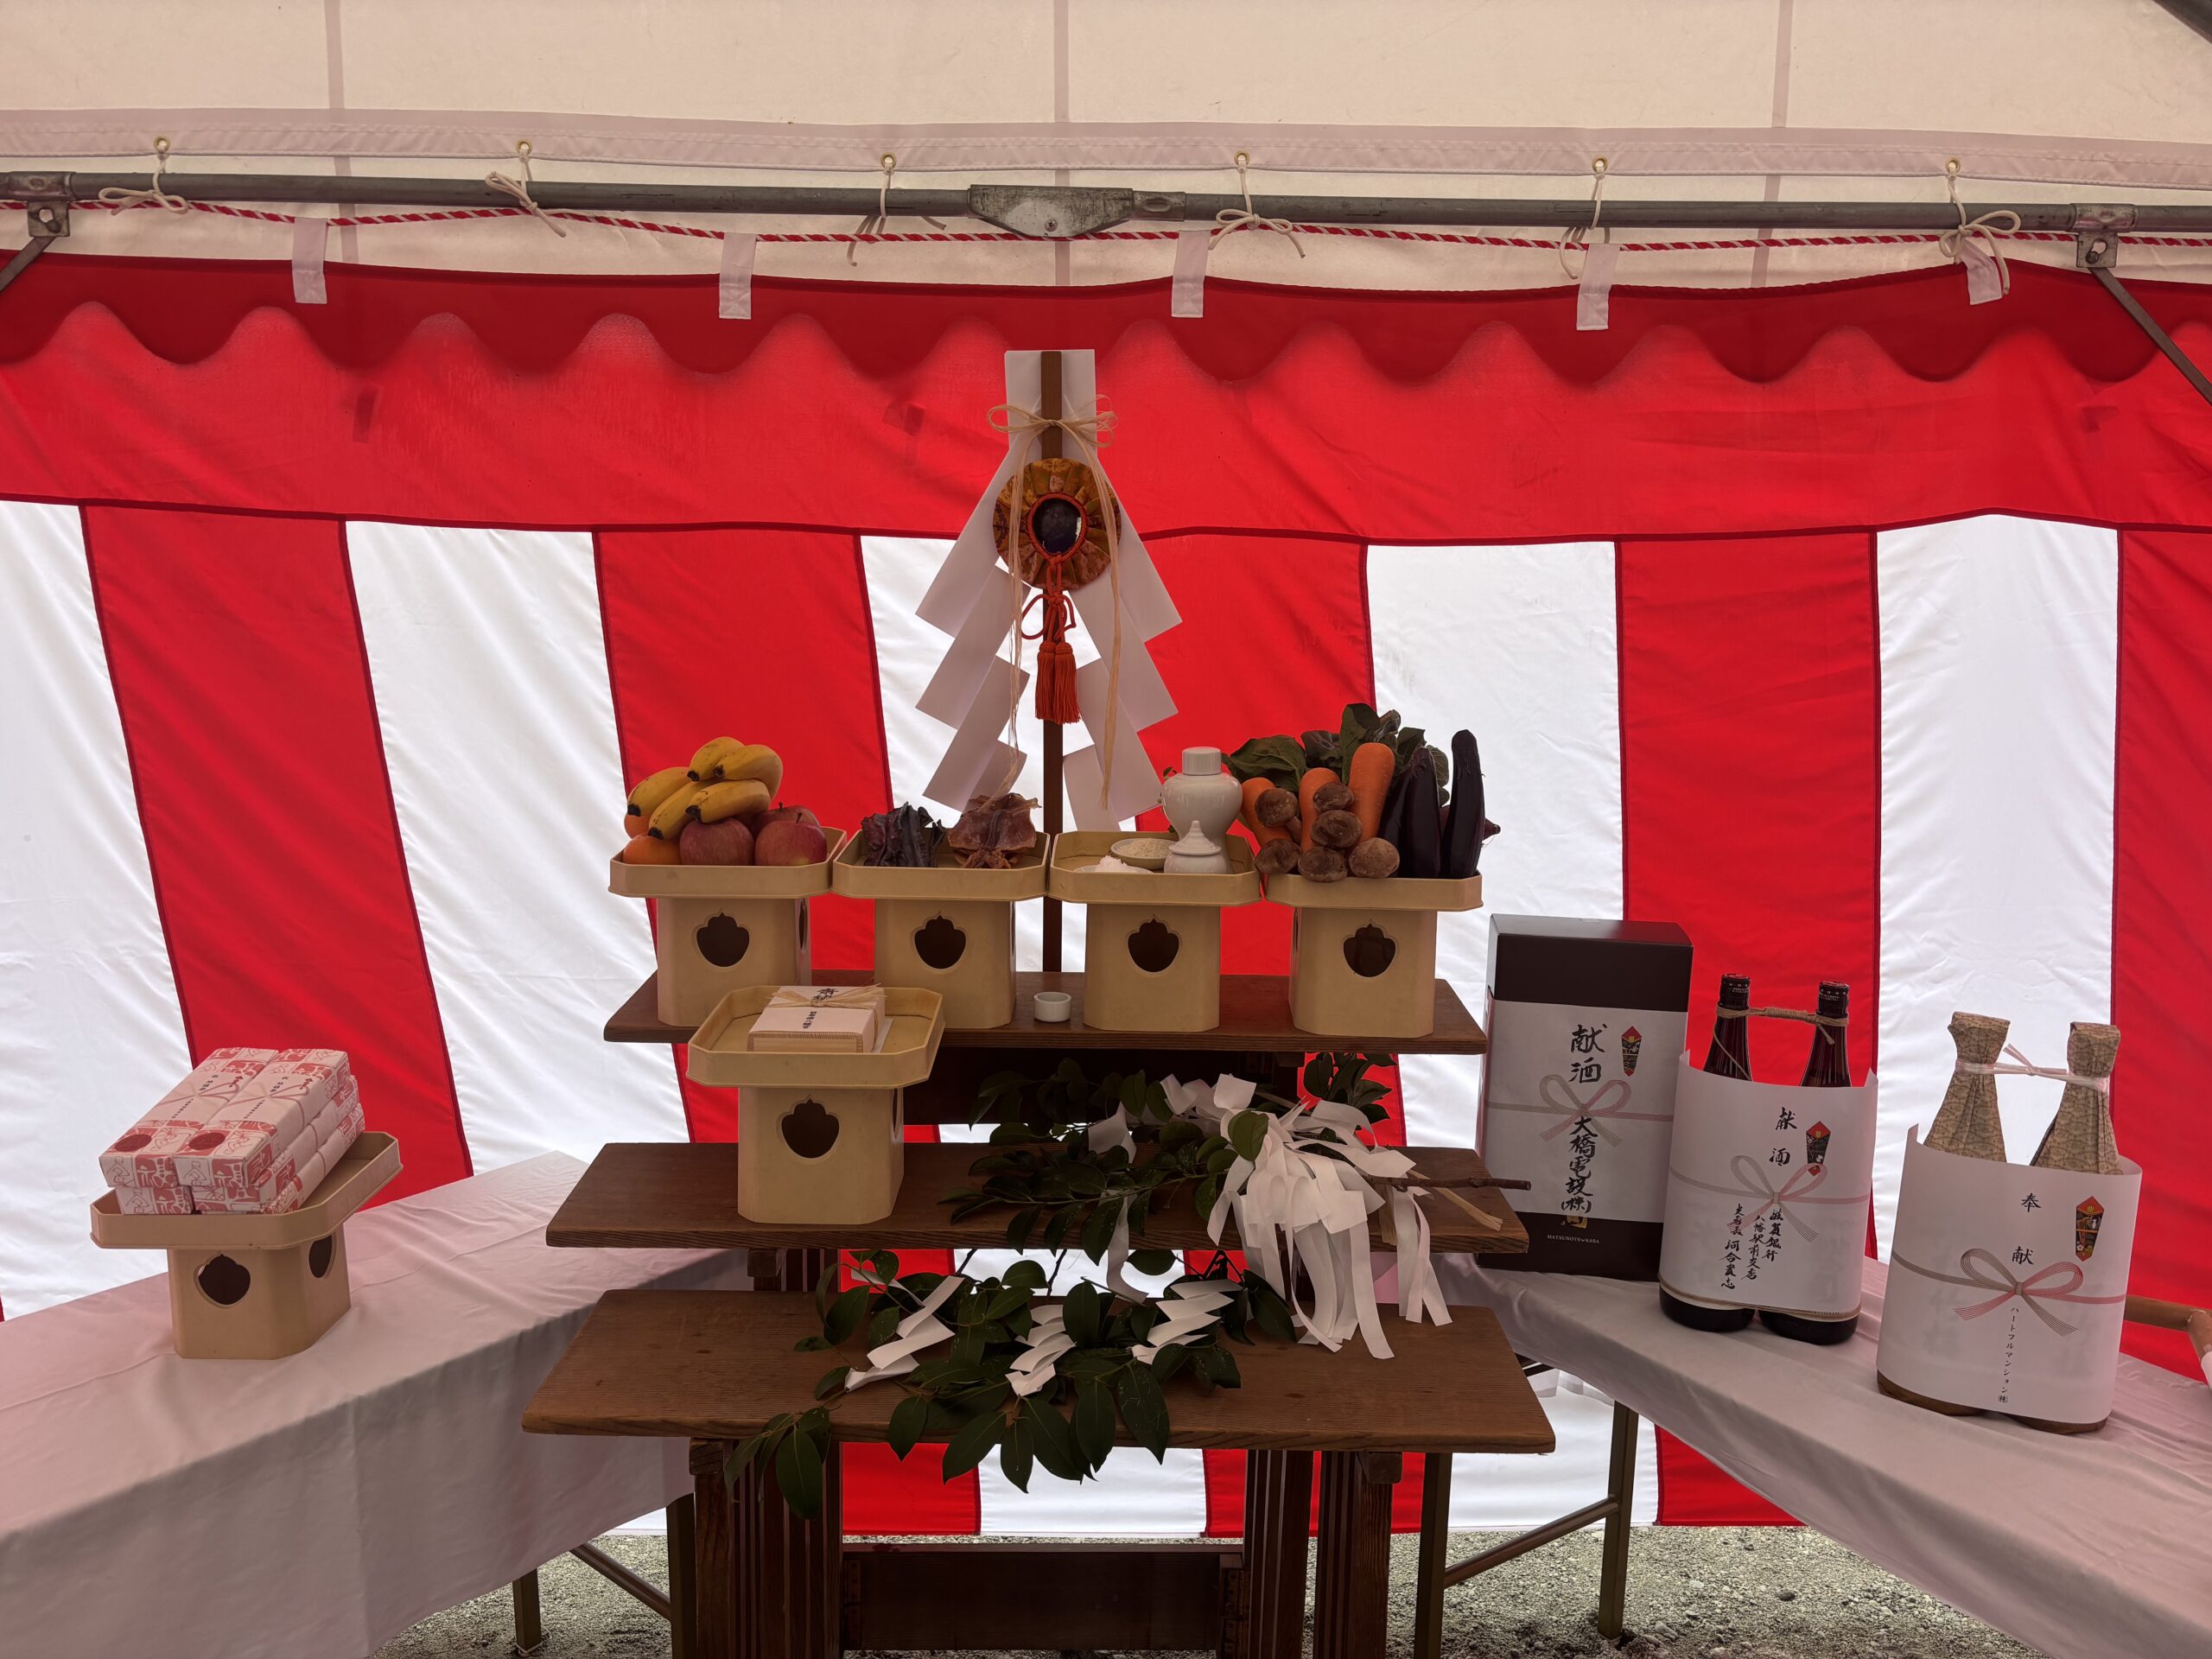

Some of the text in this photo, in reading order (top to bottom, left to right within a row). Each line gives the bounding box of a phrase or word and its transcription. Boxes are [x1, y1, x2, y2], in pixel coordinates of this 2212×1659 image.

[1568, 1023, 1608, 1084] 献酒
[1769, 1106, 1798, 1167] 献酒
[1741, 1214, 1767, 1281] 八幡駅前支店
[1762, 1208, 1784, 1262] 滋賀銀行
